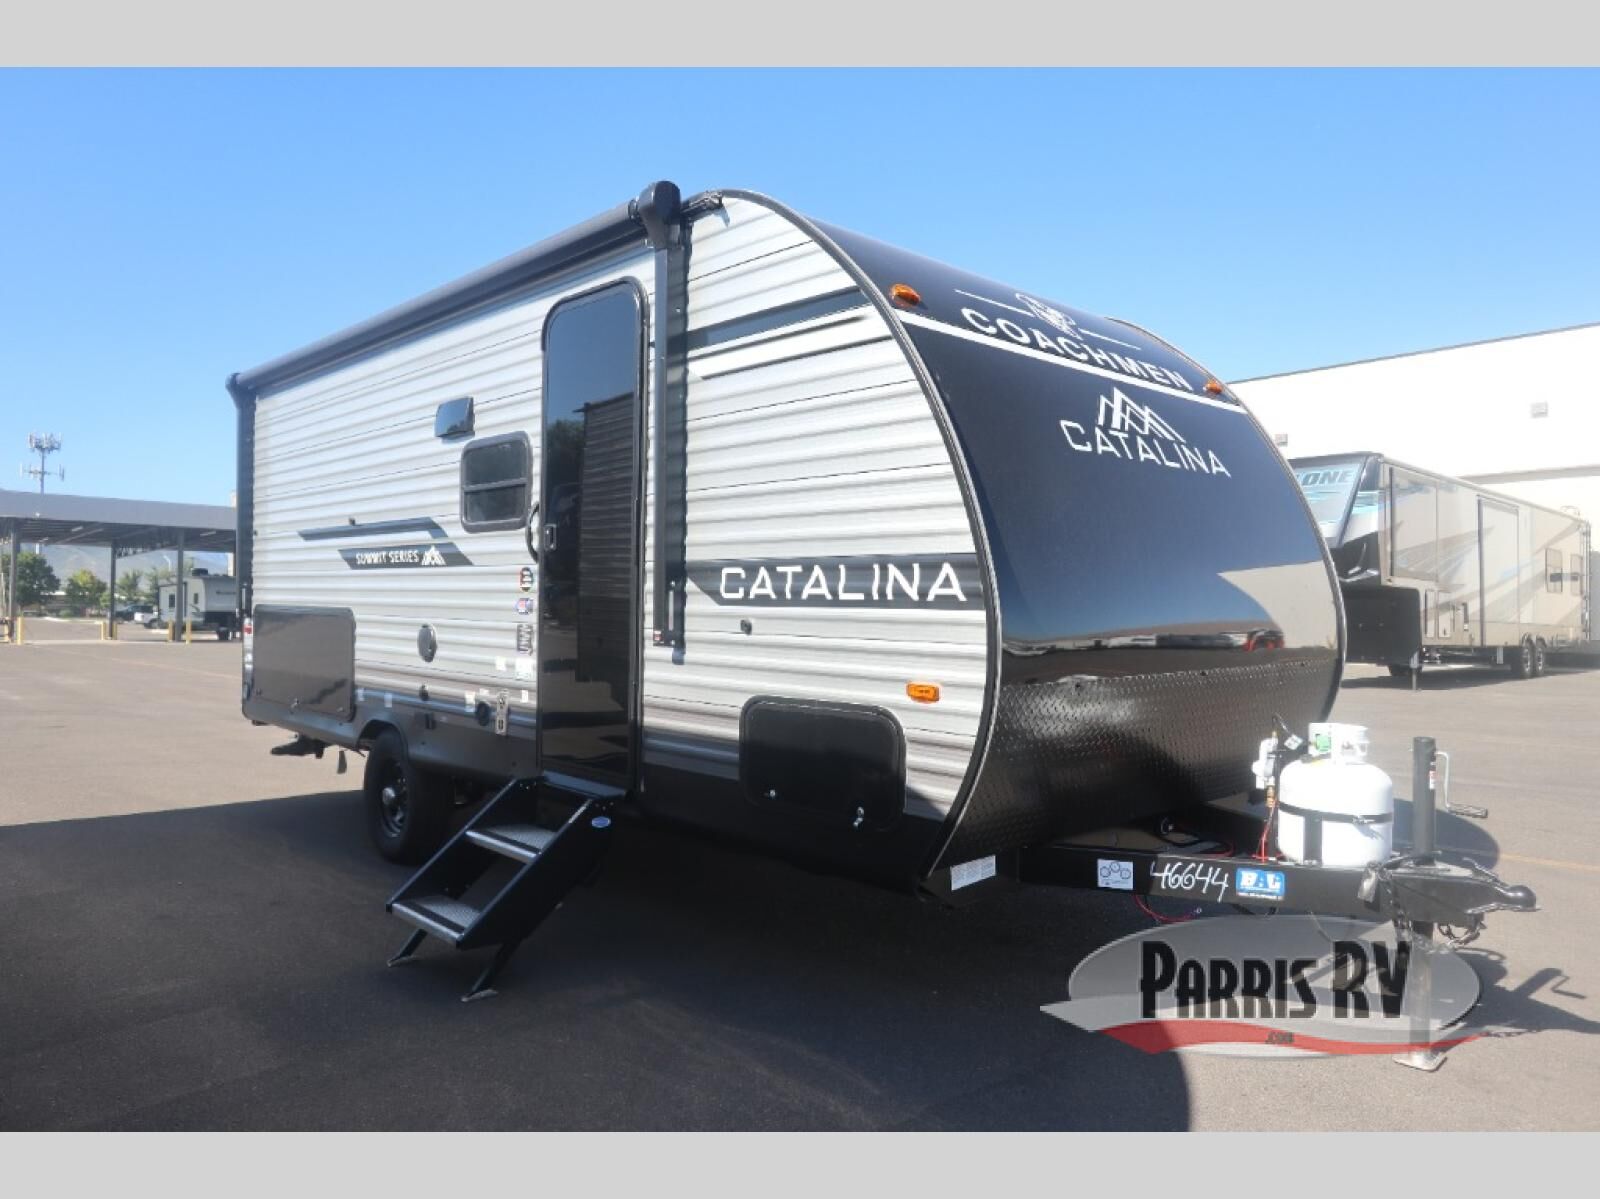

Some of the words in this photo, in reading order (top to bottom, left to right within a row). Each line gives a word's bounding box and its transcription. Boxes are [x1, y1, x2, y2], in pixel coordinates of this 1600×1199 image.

[961, 307, 1194, 392] COACHMEN
[1059, 419, 1232, 478] CATALINA
[355, 551, 387, 565] SUMMIT
[389, 549, 420, 563] SERIES
[719, 562, 968, 602] CATALINA
[1149, 860, 1229, 903] 46644
